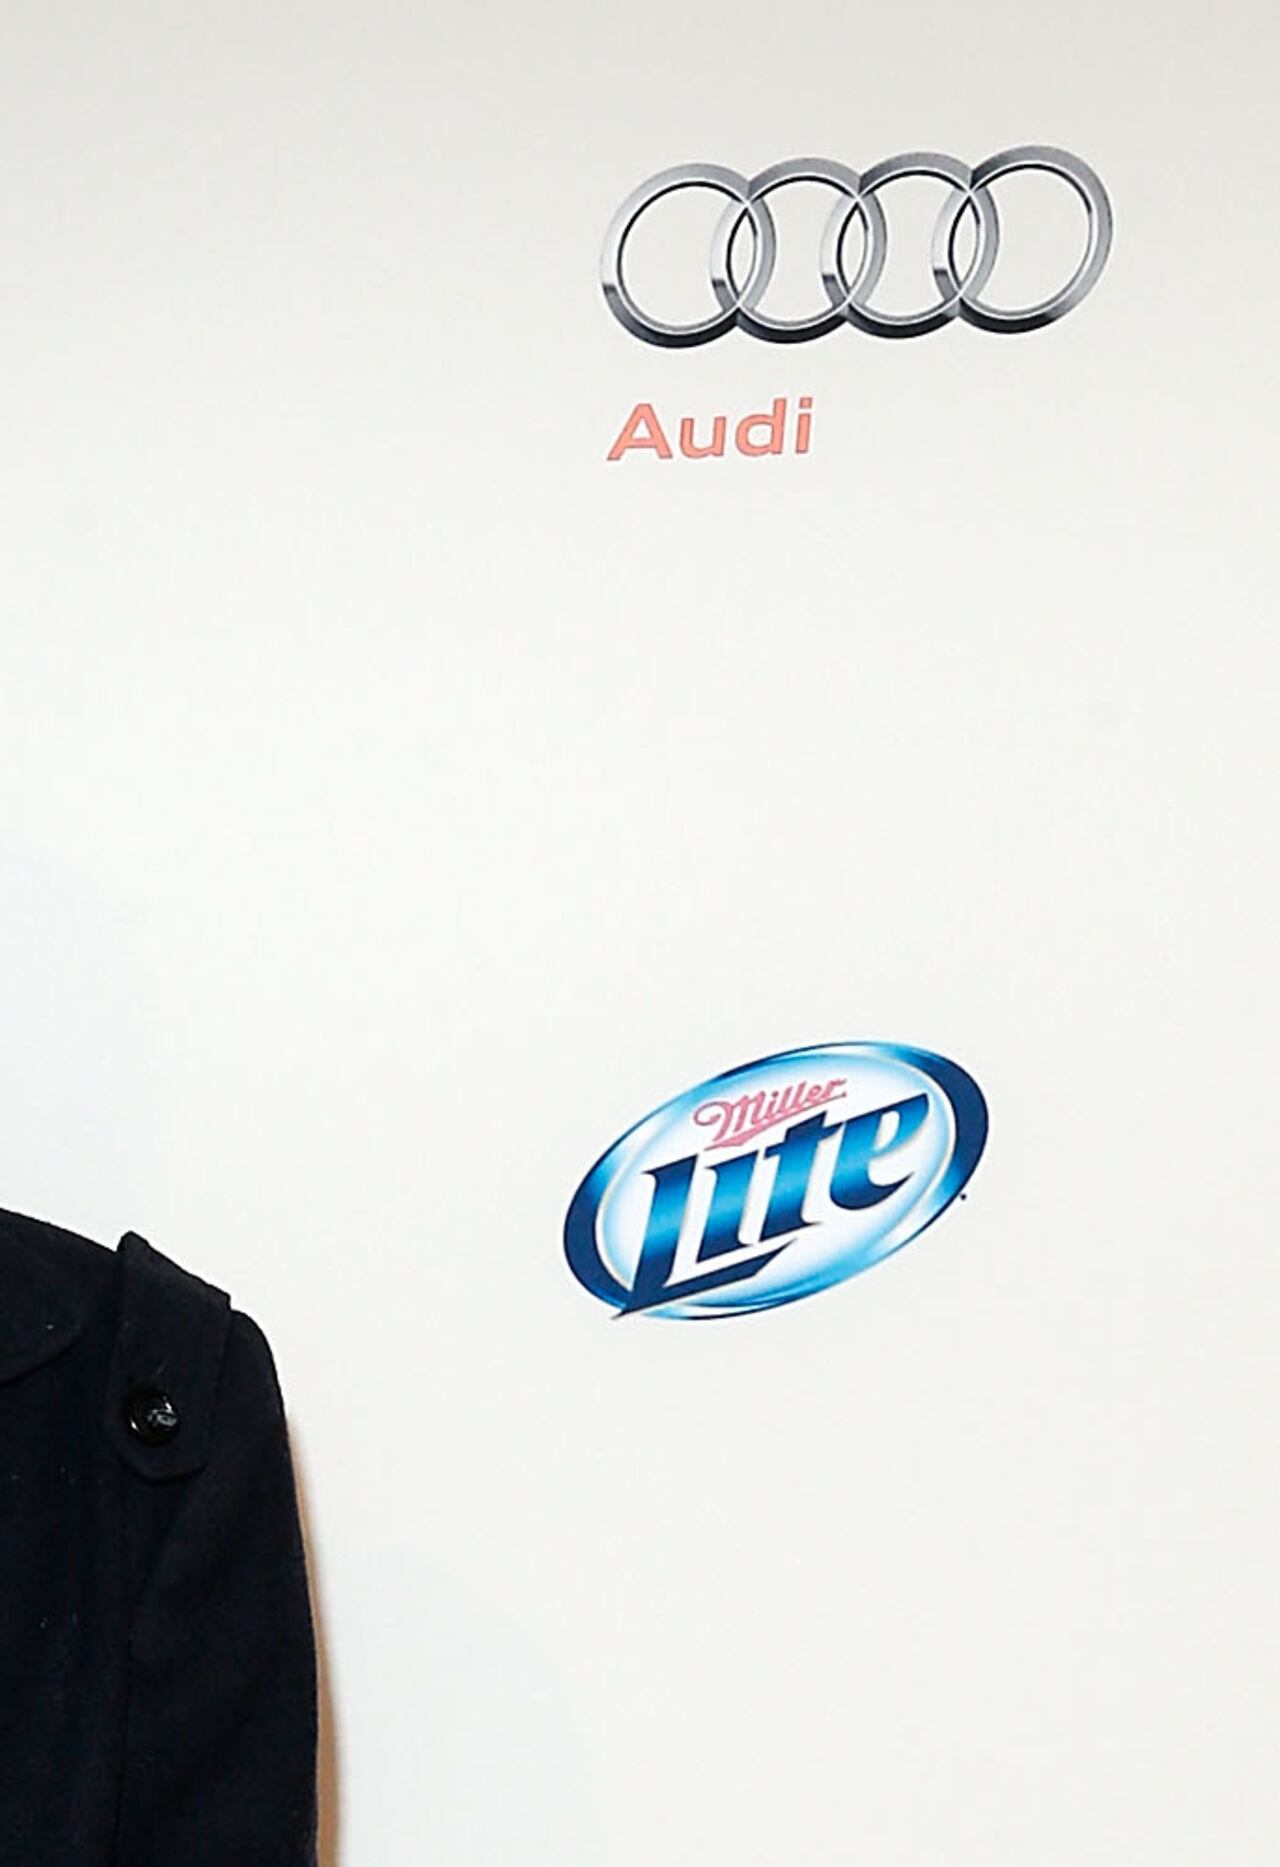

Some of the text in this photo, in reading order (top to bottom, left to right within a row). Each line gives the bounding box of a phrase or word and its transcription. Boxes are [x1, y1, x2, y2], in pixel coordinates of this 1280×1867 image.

[608, 395, 813, 461] Audi
[694, 1078, 848, 1150] Miller
[611, 1093, 928, 1320] Lite
